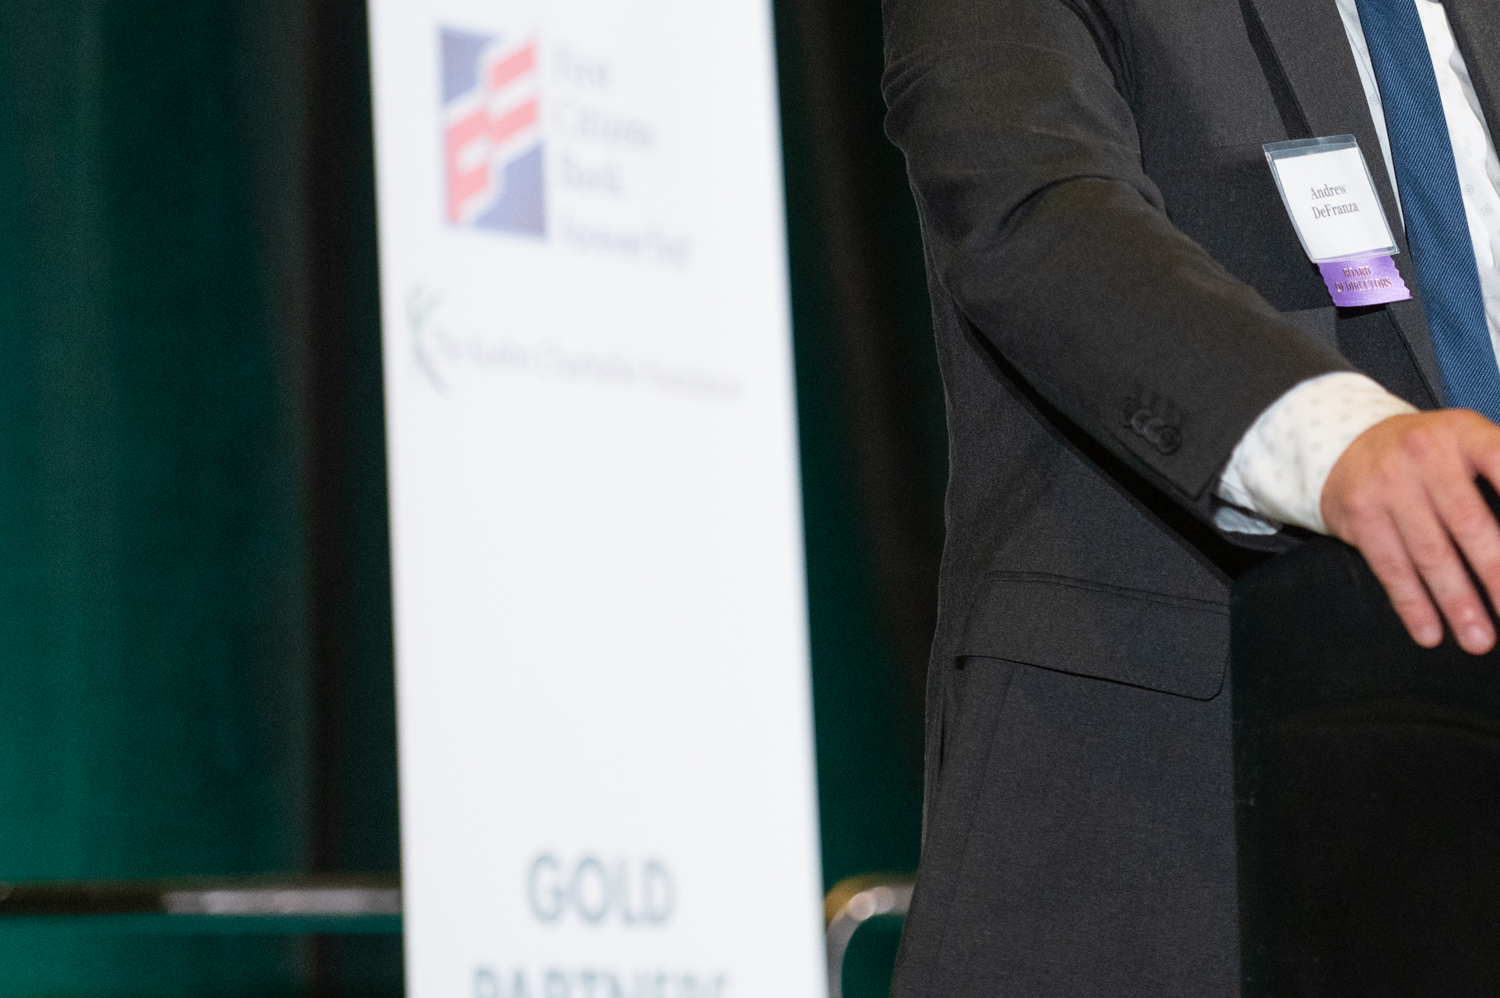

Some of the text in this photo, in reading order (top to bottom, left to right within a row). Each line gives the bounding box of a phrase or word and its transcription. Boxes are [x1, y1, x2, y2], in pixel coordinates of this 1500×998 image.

[1310, 183, 1347, 200] Andrew
[1311, 202, 1359, 219] DeFranza
[1342, 266, 1371, 278] BOARD
[1345, 277, 1392, 292] DIRECTORS
[525, 849, 676, 928] GOLD
